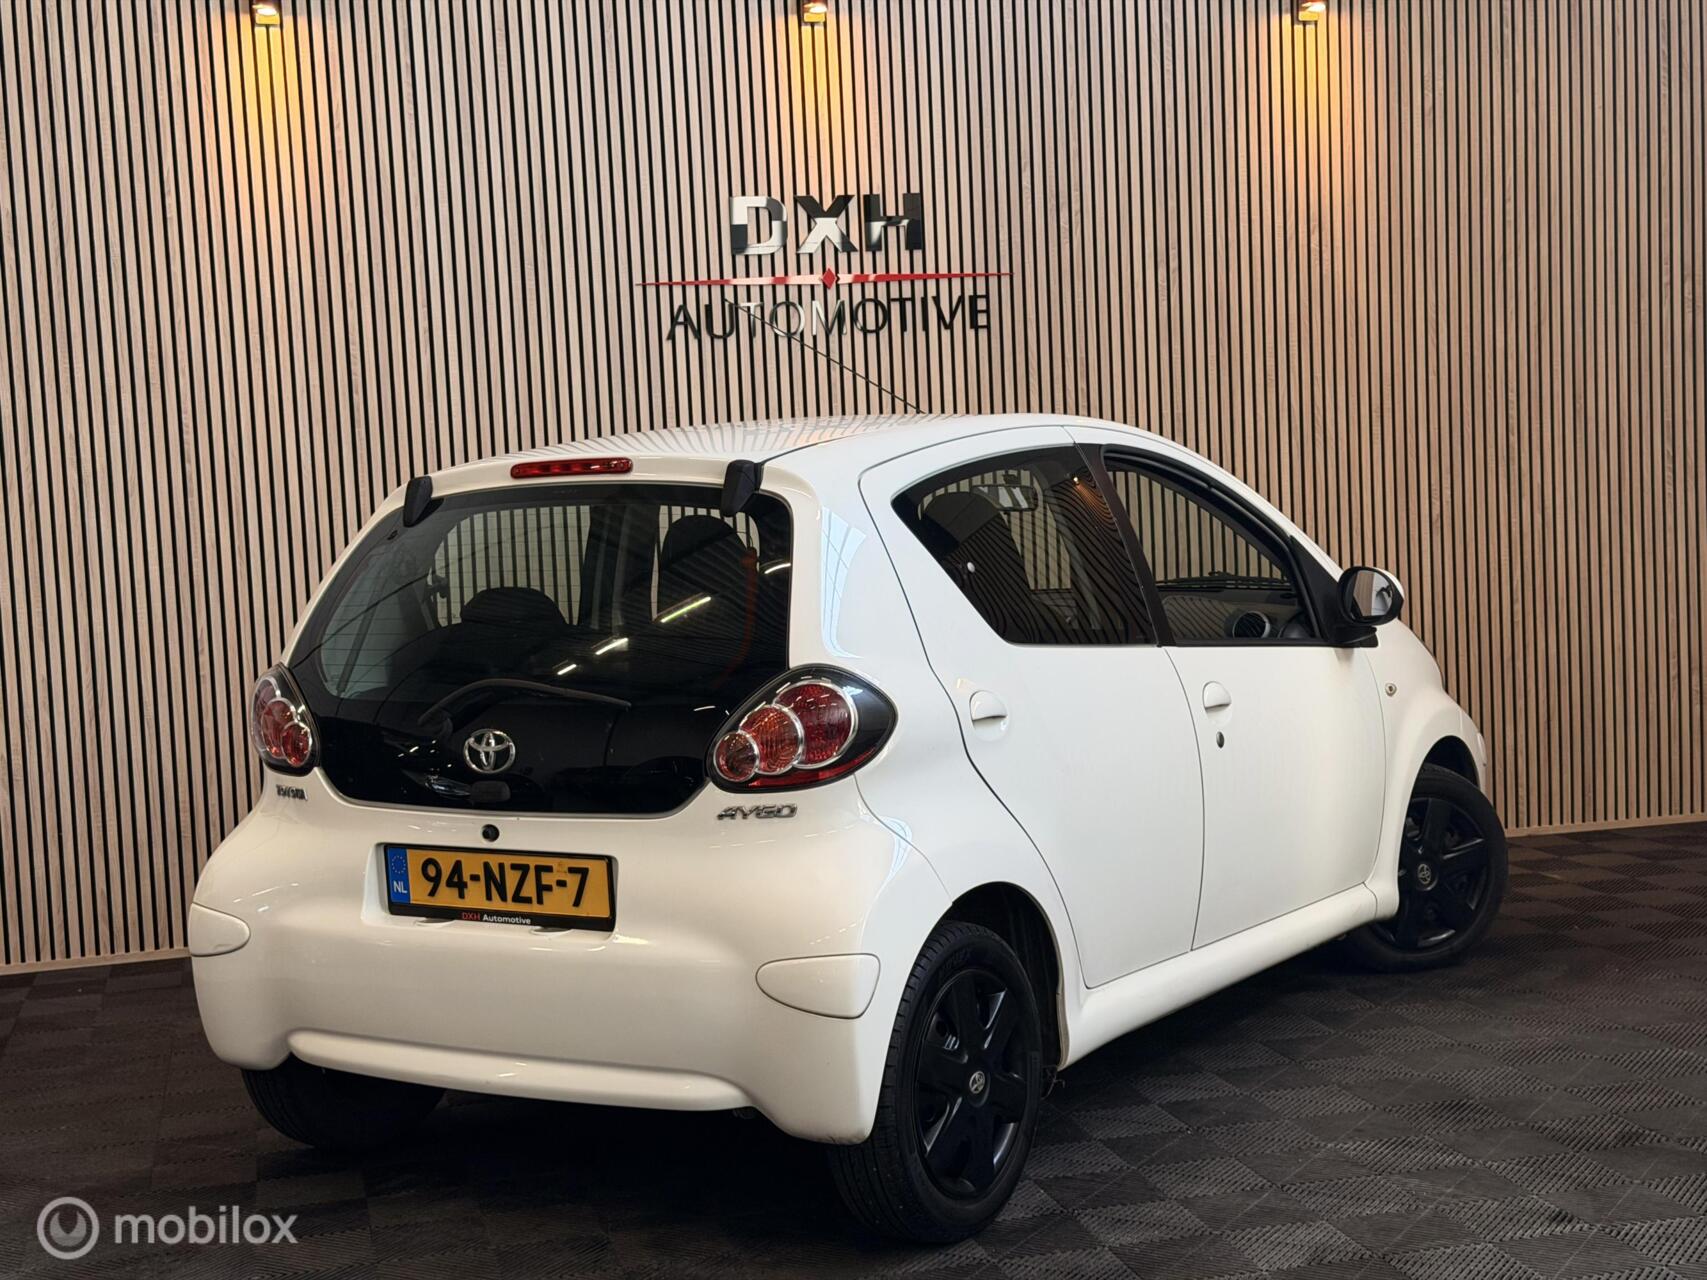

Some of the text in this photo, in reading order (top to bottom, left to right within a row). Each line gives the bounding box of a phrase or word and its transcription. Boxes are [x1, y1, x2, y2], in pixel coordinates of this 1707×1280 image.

[729, 192, 923, 255] DXH
[666, 294, 991, 340] AUTOMOTIVE
[717, 804, 797, 820] AYGO
[393, 880, 408, 894] NL
[421, 857, 590, 908] 94-NZF-7
[461, 912, 532, 925] DXH Automotive
